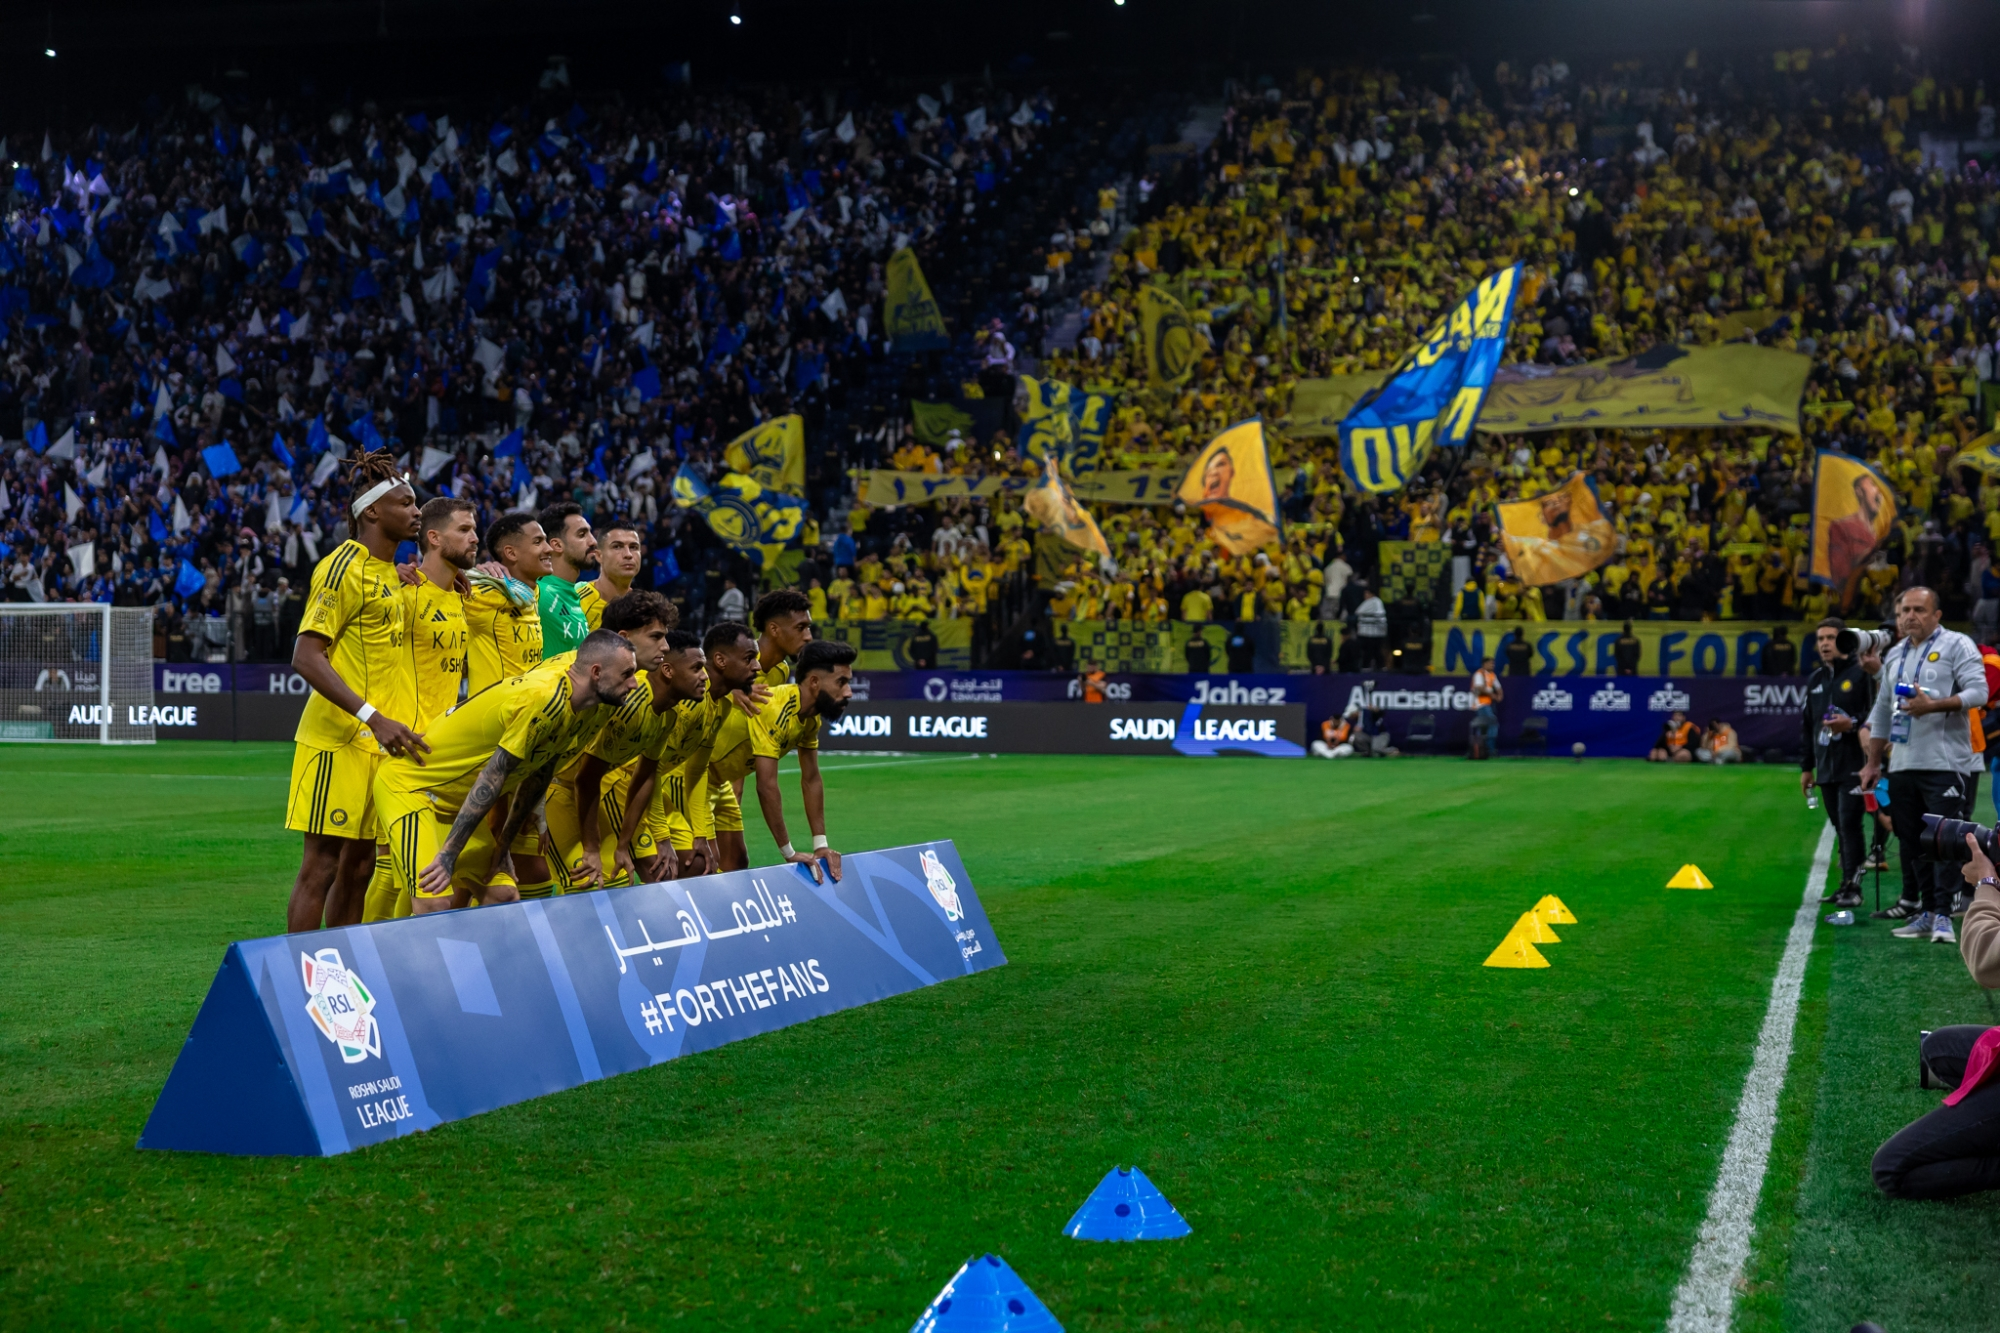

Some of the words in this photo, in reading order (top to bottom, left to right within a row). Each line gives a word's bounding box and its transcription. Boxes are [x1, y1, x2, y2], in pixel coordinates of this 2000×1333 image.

[162, 669, 222, 694] tree
[1189, 680, 1286, 705] Jahez
[128, 705, 197, 726] LEAGUE
[908, 716, 988, 738] LEAGUE
[1109, 718, 1175, 740] SAUDI
[1193, 719, 1277, 742] LEAGUE
[327, 993, 356, 1016] RSL
[640, 958, 830, 1036] #FORTHEFANS
[376, 1075, 403, 1096] SAUDI
[356, 1094, 414, 1130] LEAGUE
